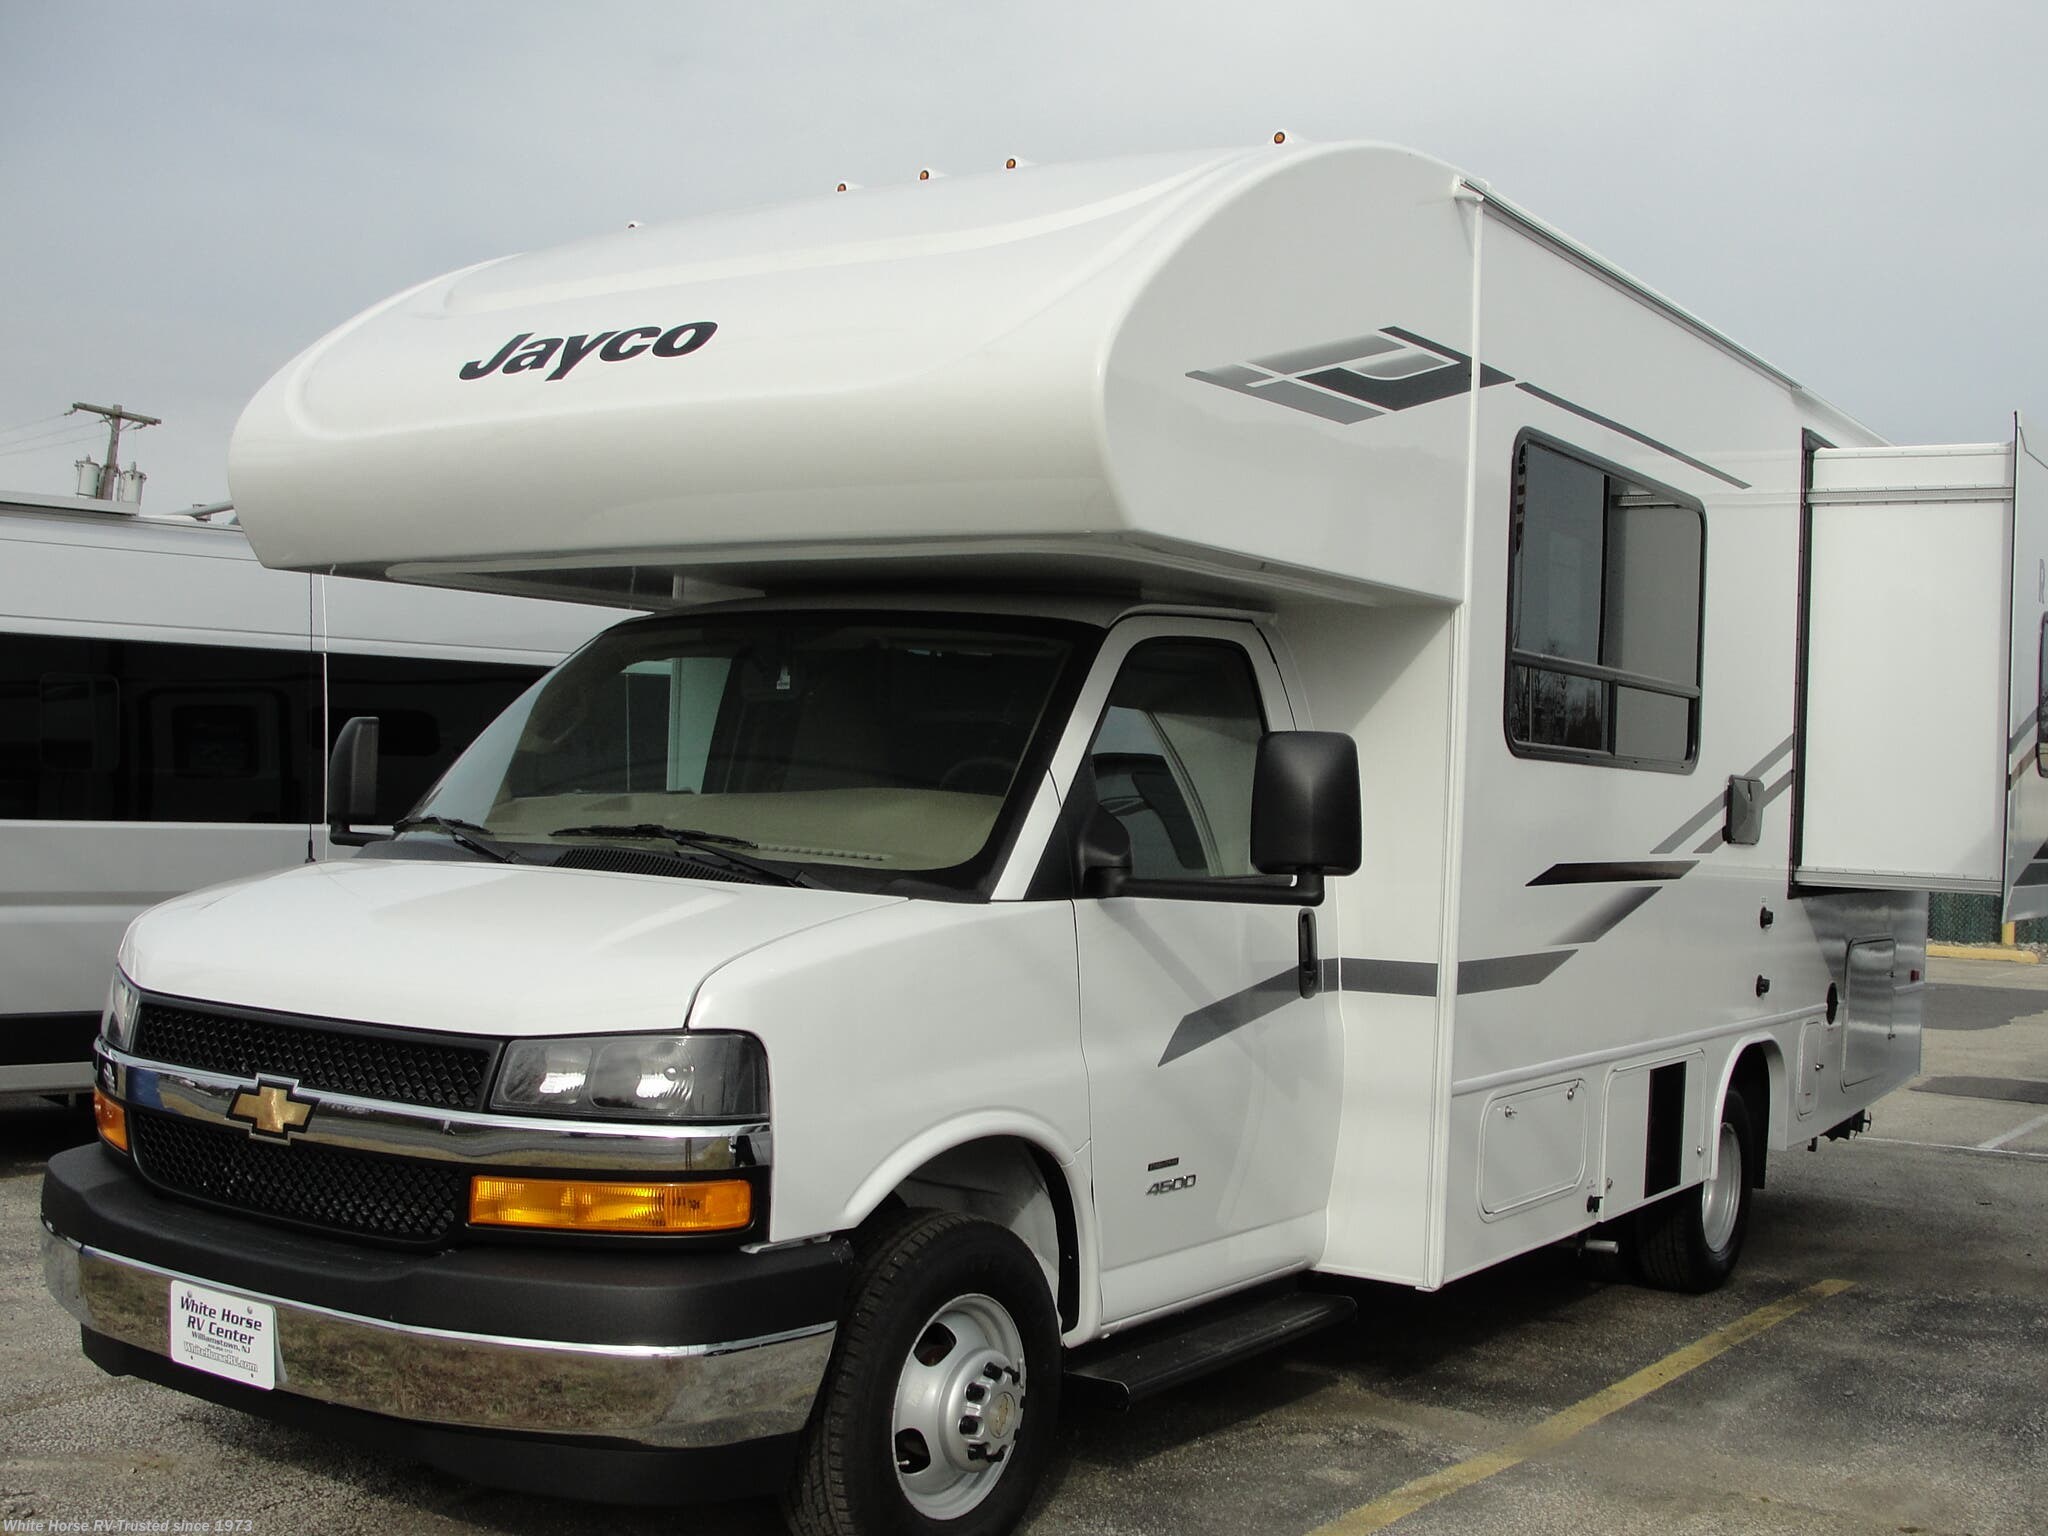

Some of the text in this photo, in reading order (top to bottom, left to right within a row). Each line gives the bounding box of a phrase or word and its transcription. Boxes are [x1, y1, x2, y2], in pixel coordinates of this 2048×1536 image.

[459, 321, 718, 381] Jayco
[180, 1296, 262, 1332] White Horse
[187, 1315, 255, 1345] RV Center
[241, 1345, 251, 1354] NJ
